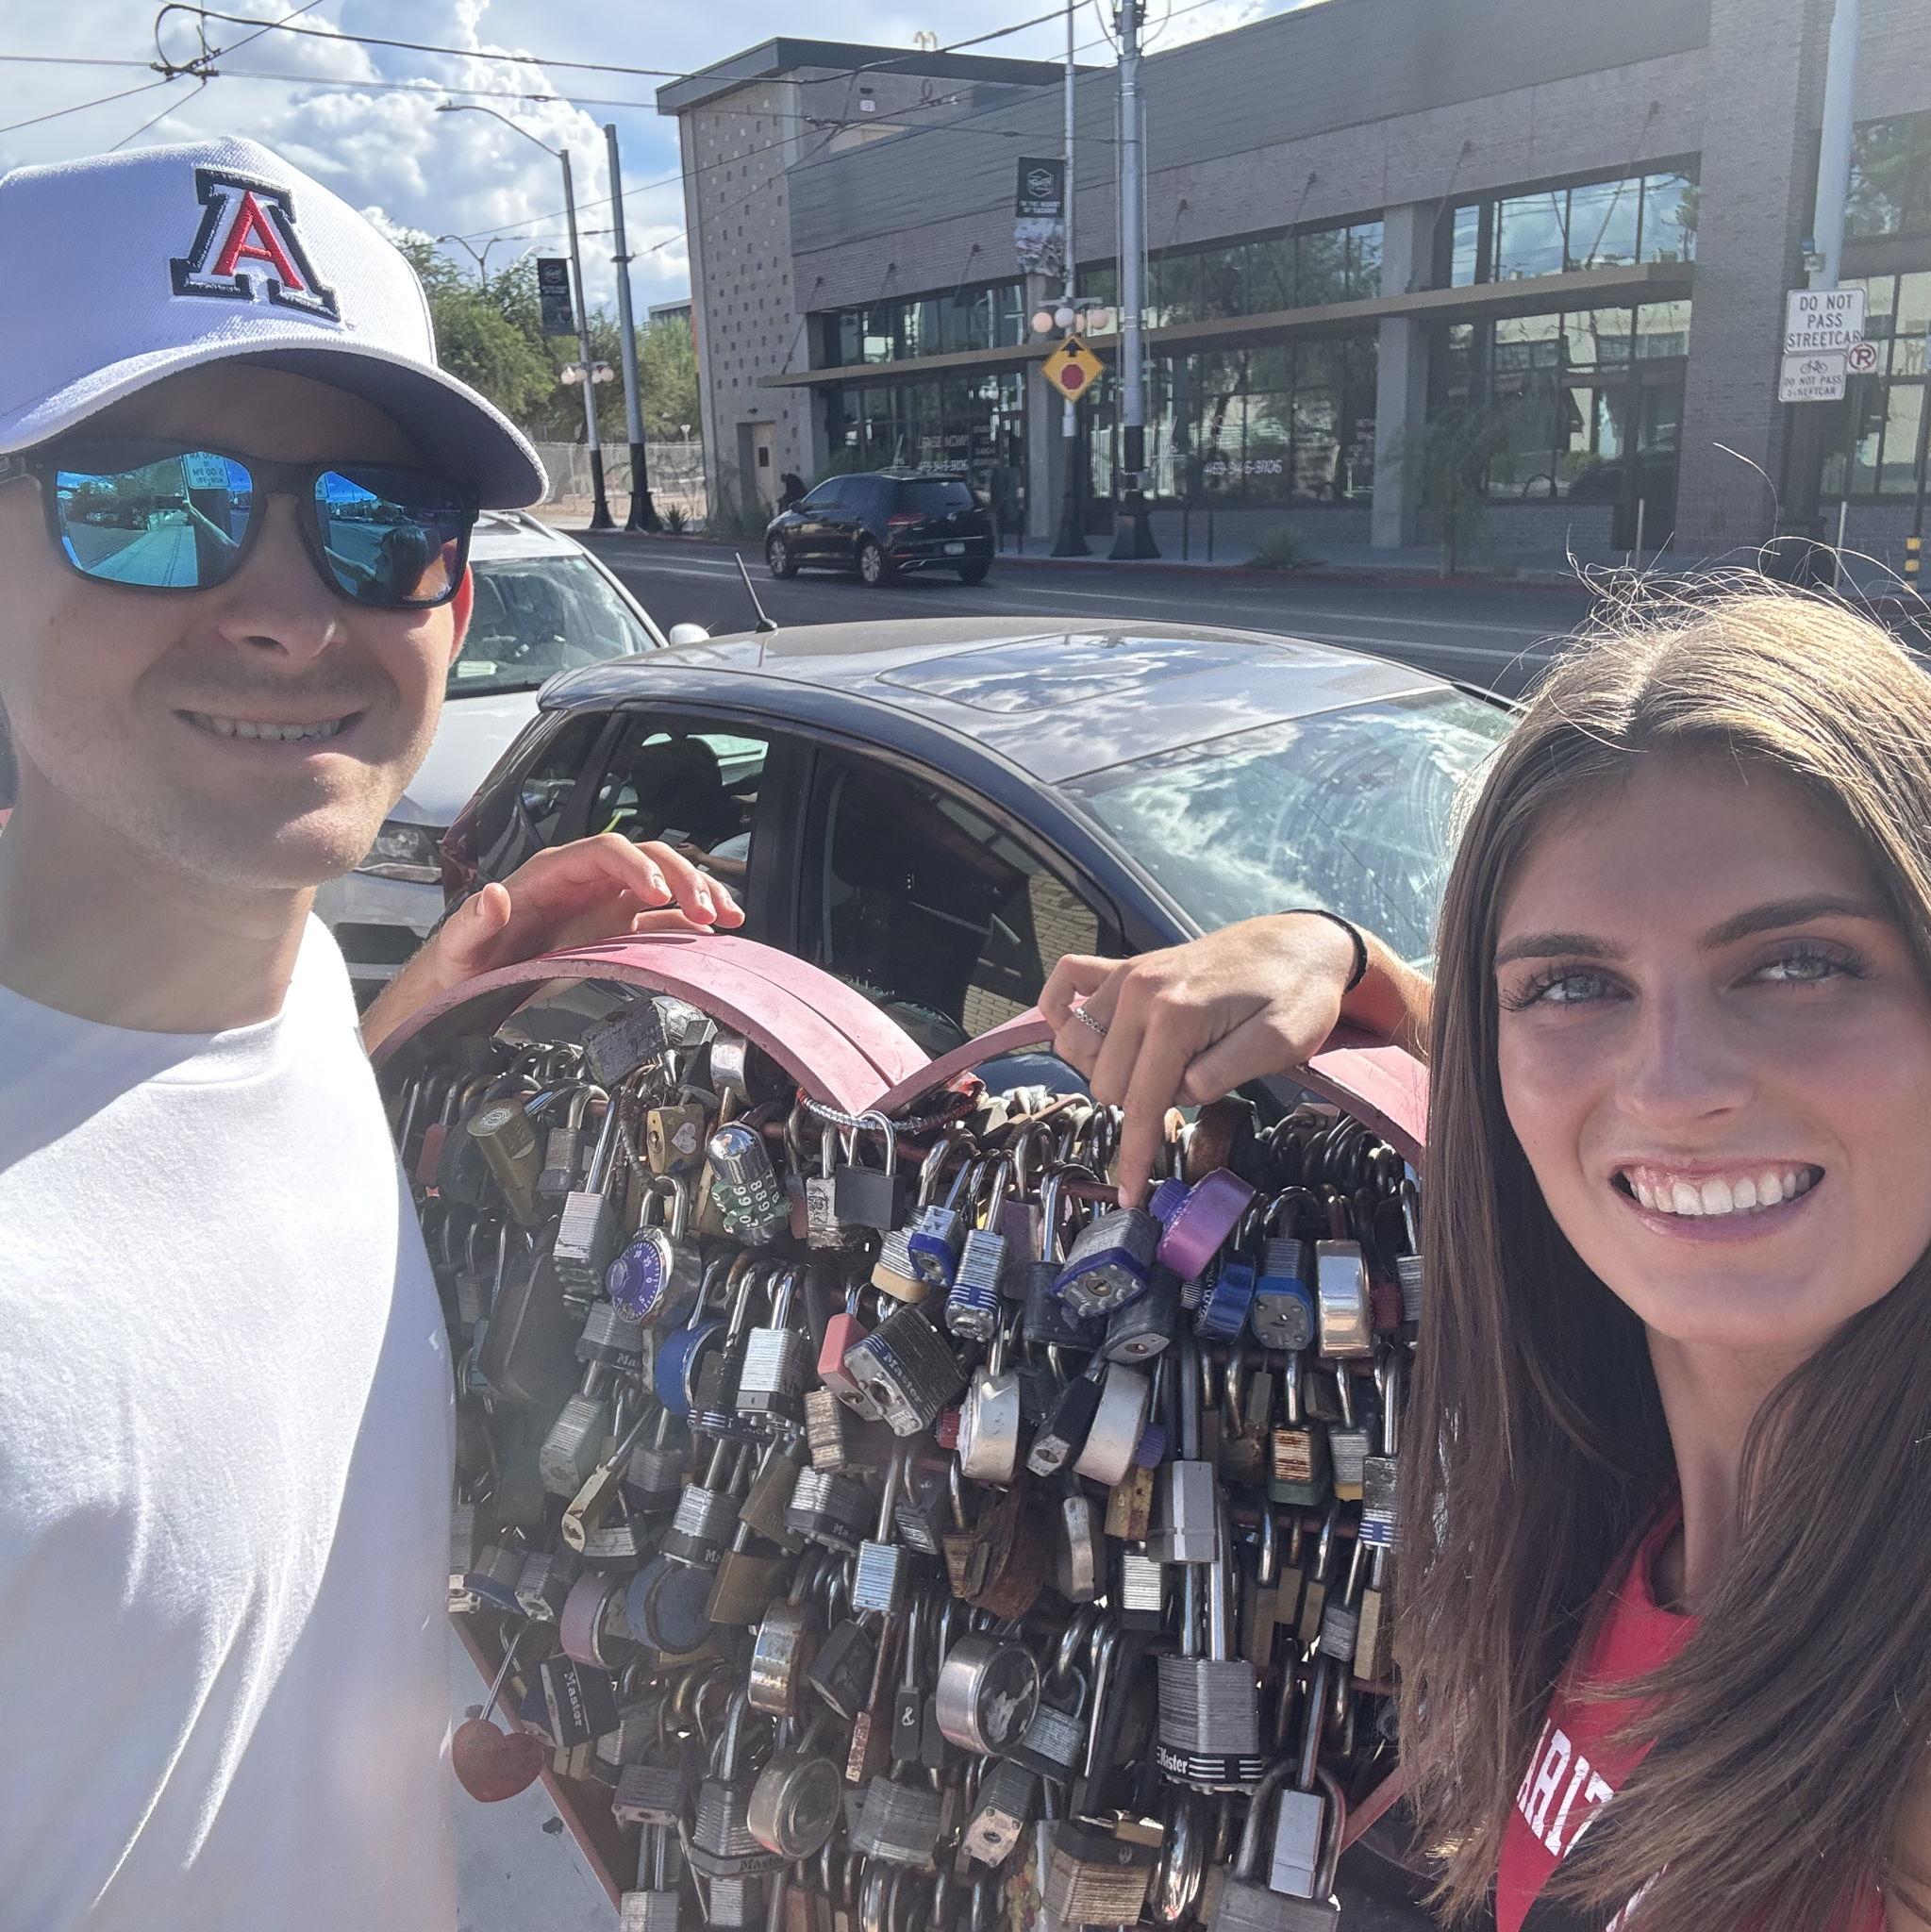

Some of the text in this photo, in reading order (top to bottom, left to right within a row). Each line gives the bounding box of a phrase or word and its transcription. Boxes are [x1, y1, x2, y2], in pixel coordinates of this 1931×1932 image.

[170, 168, 341, 323] A
[1800, 294, 1853, 311] DO NOT
[1807, 313, 1842, 329] PASS
[1788, 330, 1861, 347] STREETCAR
[564, 1671, 582, 1726] Master
